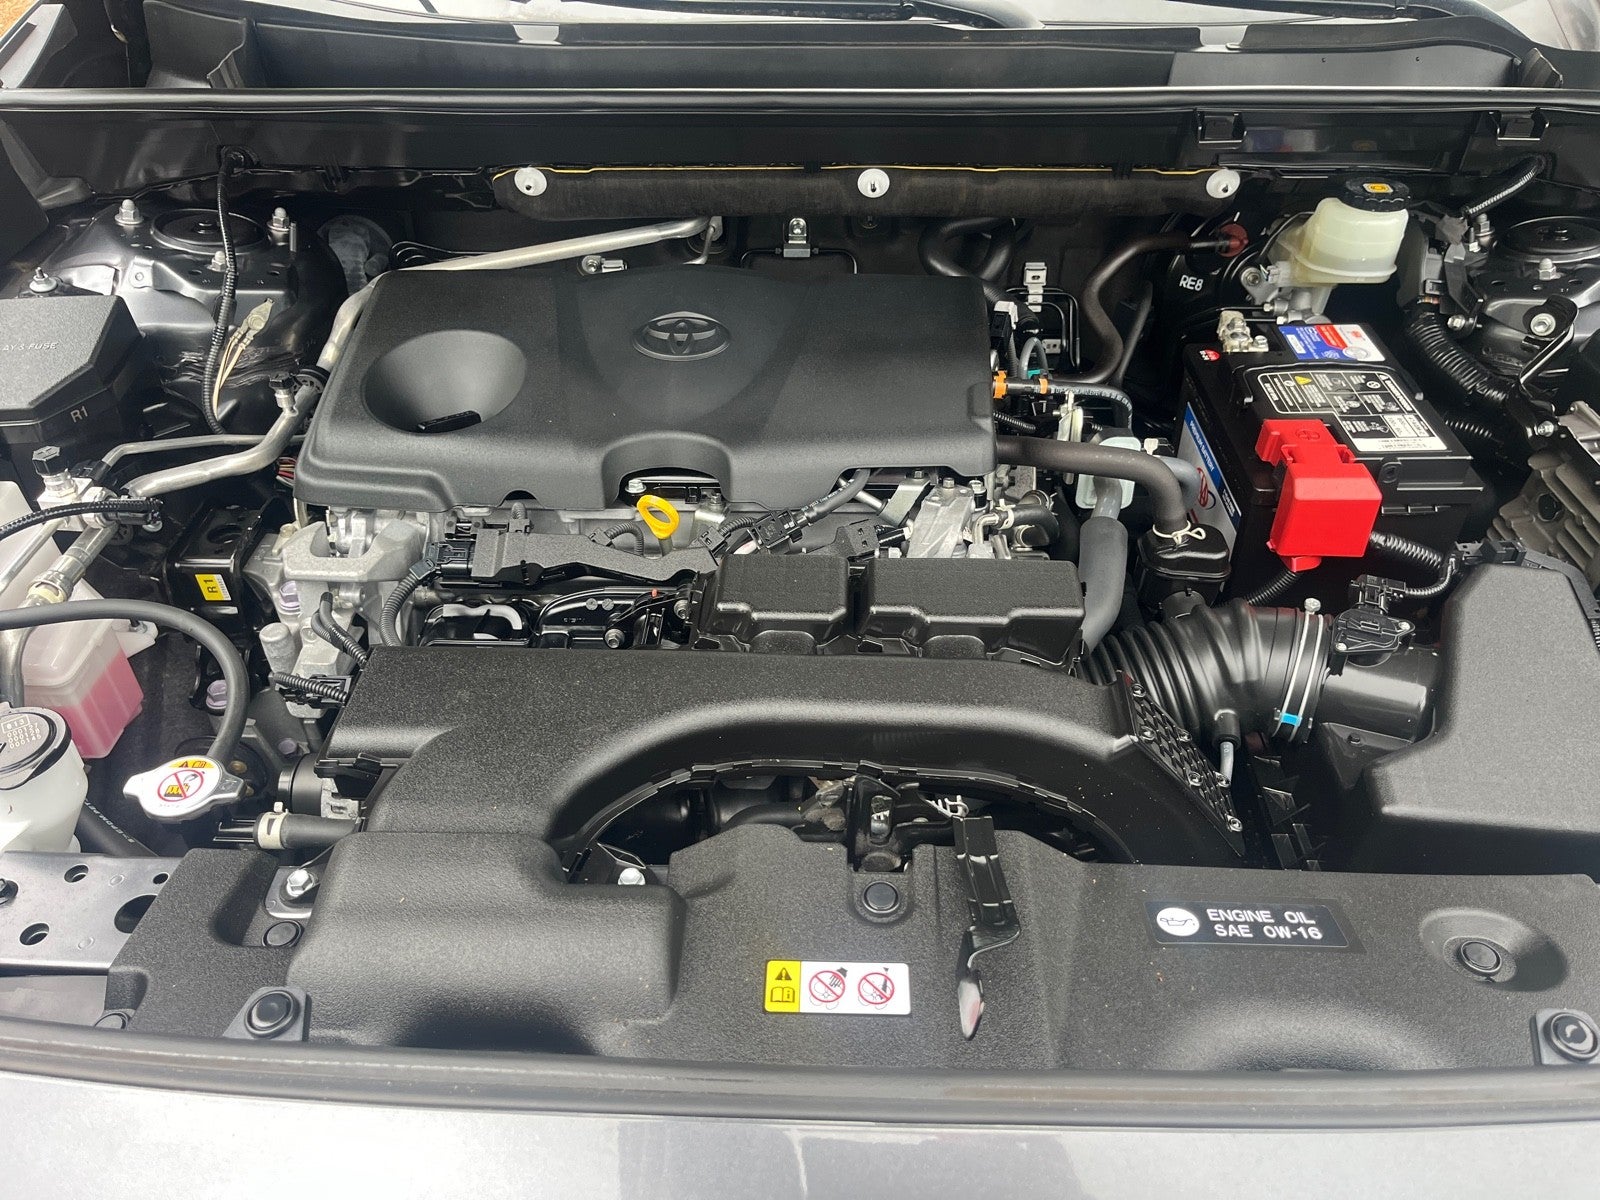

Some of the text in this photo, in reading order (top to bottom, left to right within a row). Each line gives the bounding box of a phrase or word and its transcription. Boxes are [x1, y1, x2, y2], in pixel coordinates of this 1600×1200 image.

[1179, 274, 1204, 292] RE8
[28, 341, 58, 351] FUSE
[70, 405, 89, 423] R1
[203, 579, 219, 593] R1
[1206, 908, 1316, 925] ENGINE OIL
[1214, 924, 1254, 938] SAE
